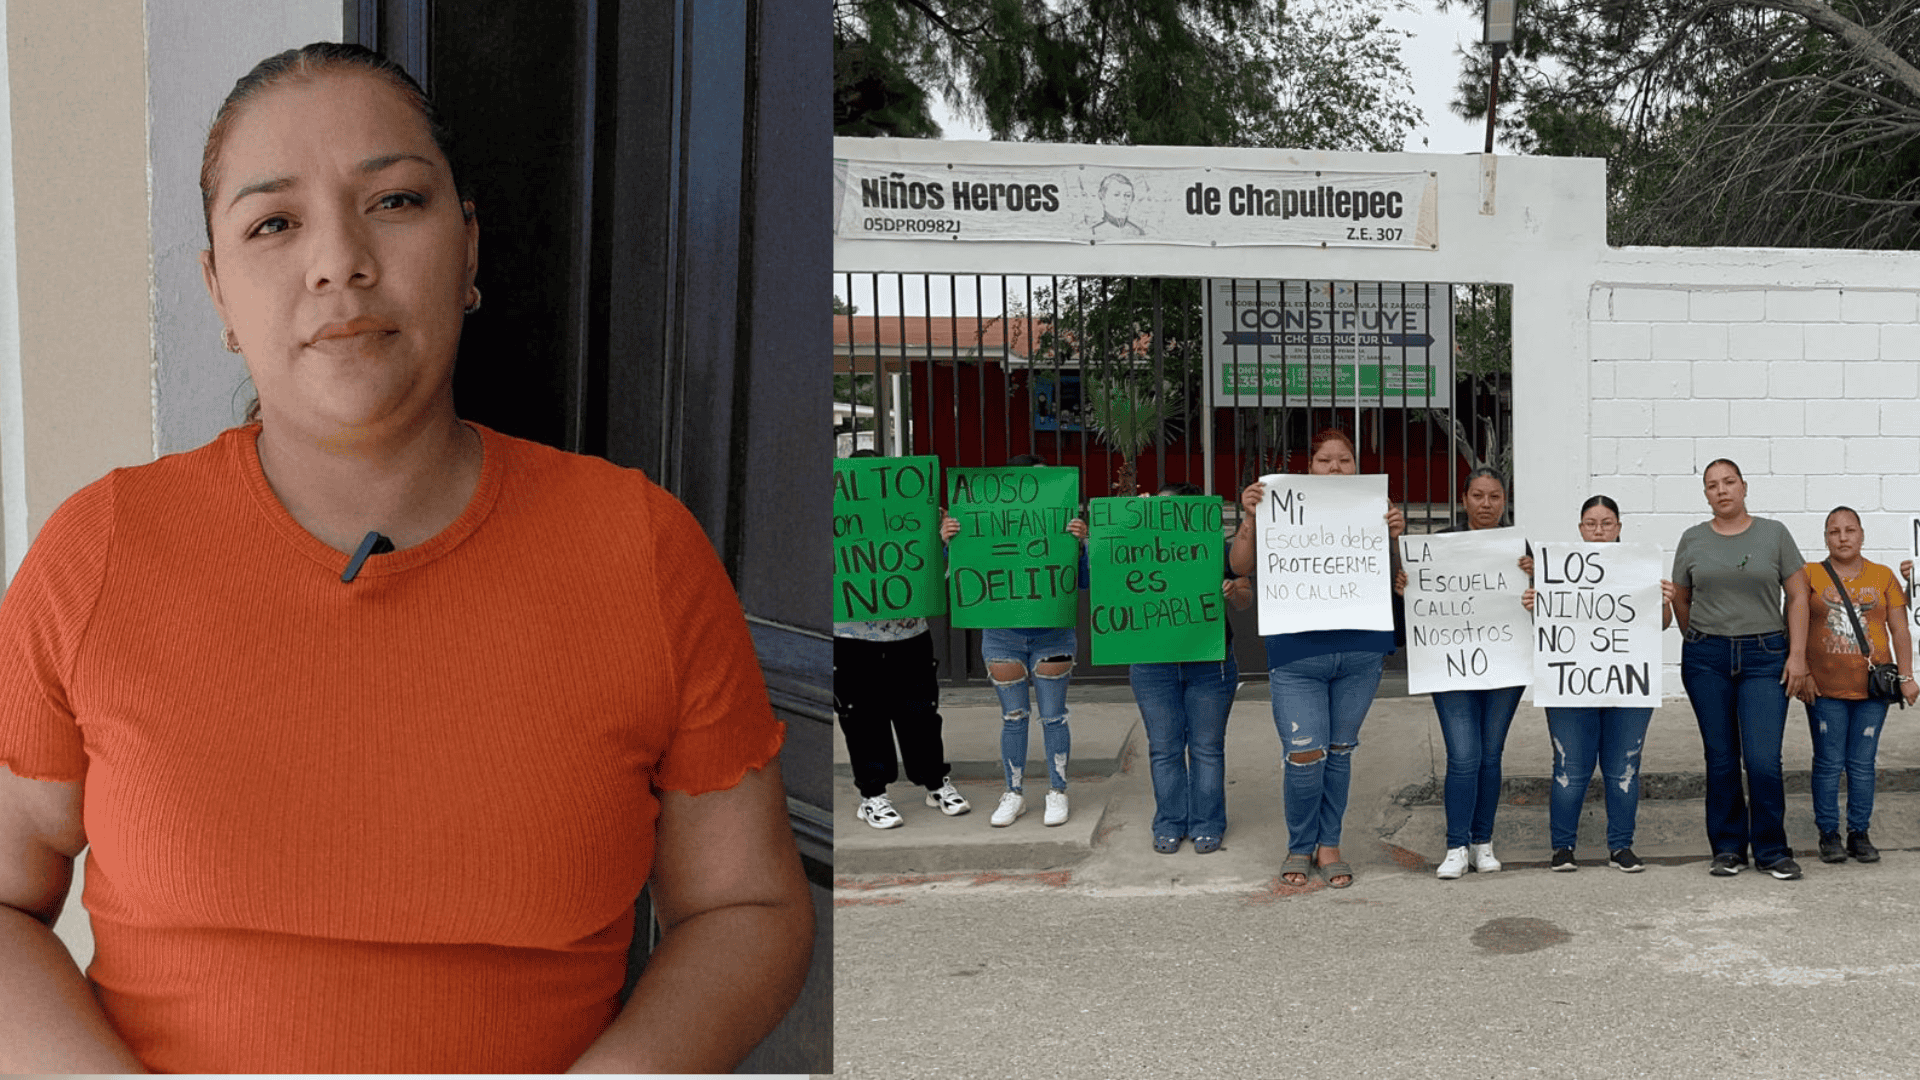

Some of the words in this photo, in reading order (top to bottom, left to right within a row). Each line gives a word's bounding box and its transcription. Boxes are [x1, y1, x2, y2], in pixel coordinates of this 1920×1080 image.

[861, 172, 945, 210] Niños
[952, 181, 1060, 212] Heroes
[1186, 182, 1221, 216] de
[1229, 184, 1403, 221] Chapultepec
[864, 217, 960, 233] 05DPR0982J
[1346, 227, 1372, 241] Z.E.
[1376, 228, 1403, 241] 307
[1241, 309, 1417, 330] CONSTRUYE
[952, 472, 1039, 504] ACOSO
[882, 507, 921, 535] los
[1092, 502, 1118, 527] EL
[1124, 500, 1223, 533] SILENCIO
[1271, 488, 1306, 526] Mi
[1100, 536, 1209, 565] Tambien
[1265, 524, 1335, 550] Escuela
[1341, 525, 1383, 551] debe
[1404, 541, 1433, 563] LA
[834, 537, 925, 574] IÑOS
[1541, 547, 1605, 584] LOS
[842, 574, 913, 619] NO
[954, 564, 1077, 608] DELITO
[1126, 570, 1167, 593] es
[1266, 584, 1290, 600] NO
[1296, 582, 1361, 601] CALLAR
[1418, 568, 1508, 593] ESCUELA
[1092, 592, 1219, 635] CULPABLE
[1536, 586, 1636, 623] NIÑOS
[1538, 625, 1576, 654] NO
[1590, 627, 1630, 653] SE
[1446, 646, 1489, 678] NO
[1547, 661, 1650, 697] TOCAN
